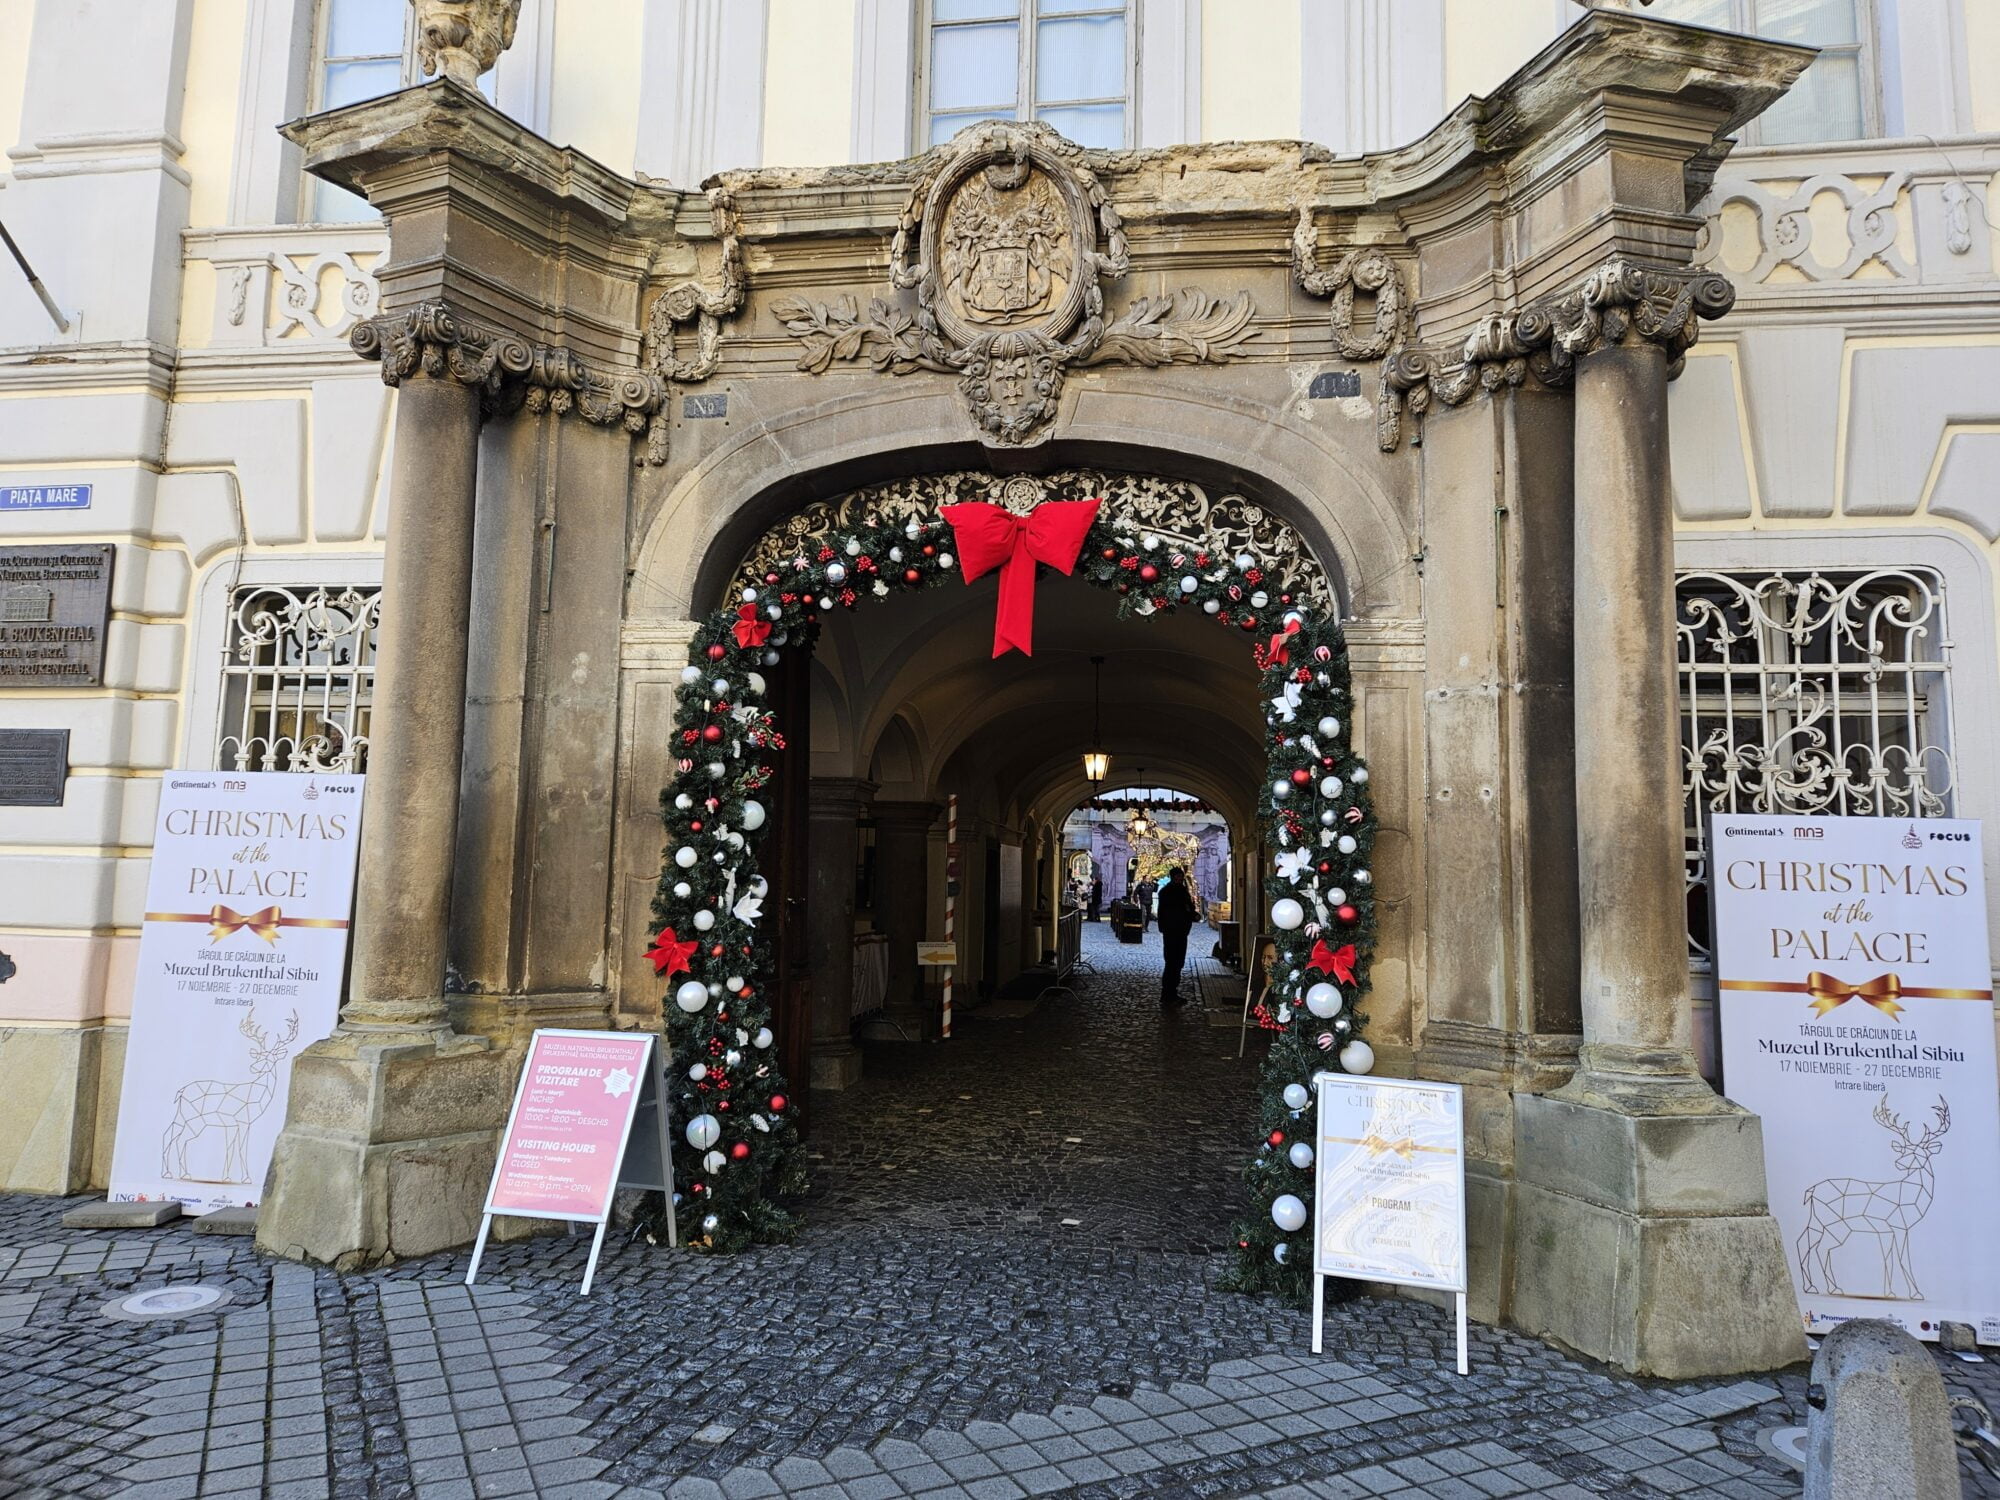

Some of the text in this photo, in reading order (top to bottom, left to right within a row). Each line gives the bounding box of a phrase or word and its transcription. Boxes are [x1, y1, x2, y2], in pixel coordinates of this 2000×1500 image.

[10, 488, 78, 507] PIAȚA MARE
[43, 569, 99, 580] BRUKENTHAL
[12, 626, 95, 642] BRUKENTHAL
[26, 649, 38, 658] DE
[19, 663, 89, 675] BRUKENTHAL
[171, 780, 211, 789] Continental
[325, 785, 355, 794] FOCUS
[165, 809, 347, 840] CHRISTMAS
[1724, 826, 1776, 838] Continental
[1929, 833, 1971, 842] FOCUS
[232, 842, 271, 864] at the
[188, 867, 308, 898] PALACE
[1727, 860, 1968, 897] CHRISTMAS
[1823, 898, 1873, 924] at the
[1771, 928, 1930, 964] PALACE
[225, 951, 234, 961] DE
[266, 953, 276, 963] DE
[277, 953, 286, 964] LA
[164, 962, 319, 981] Muzeul Brukenthal Sibiu
[177, 980, 186, 991] 17
[188, 981, 231, 993] NOIEMBRIE
[239, 983, 250, 994] 27
[252, 984, 299, 996] DECEMBRIE
[1800, 1023, 1917, 1041] TÂRGUL DE CRĂCIUN DE LA
[1758, 1038, 1965, 1062] Muzeul Brukenthal Sibiu
[538, 1065, 602, 1078] PROGRAM DE
[1780, 1060, 1791, 1072] 17
[1795, 1061, 1851, 1075] NOIEMBRIE
[1864, 1063, 1878, 1076] 27
[1882, 1064, 1942, 1080] DECEMBRIE
[535, 1075, 579, 1086] VIZITARE
[1834, 1079, 1886, 1092] Intrare liberă
[525, 1113, 543, 1121] 10:00
[517, 1139, 596, 1153] VISITING HOURS
[511, 1160, 540, 1169] CLOSED
[570, 1184, 591, 1192] OPEN
[115, 1193, 135, 1202] ING
[1372, 1197, 1411, 1211] PROGRAM
